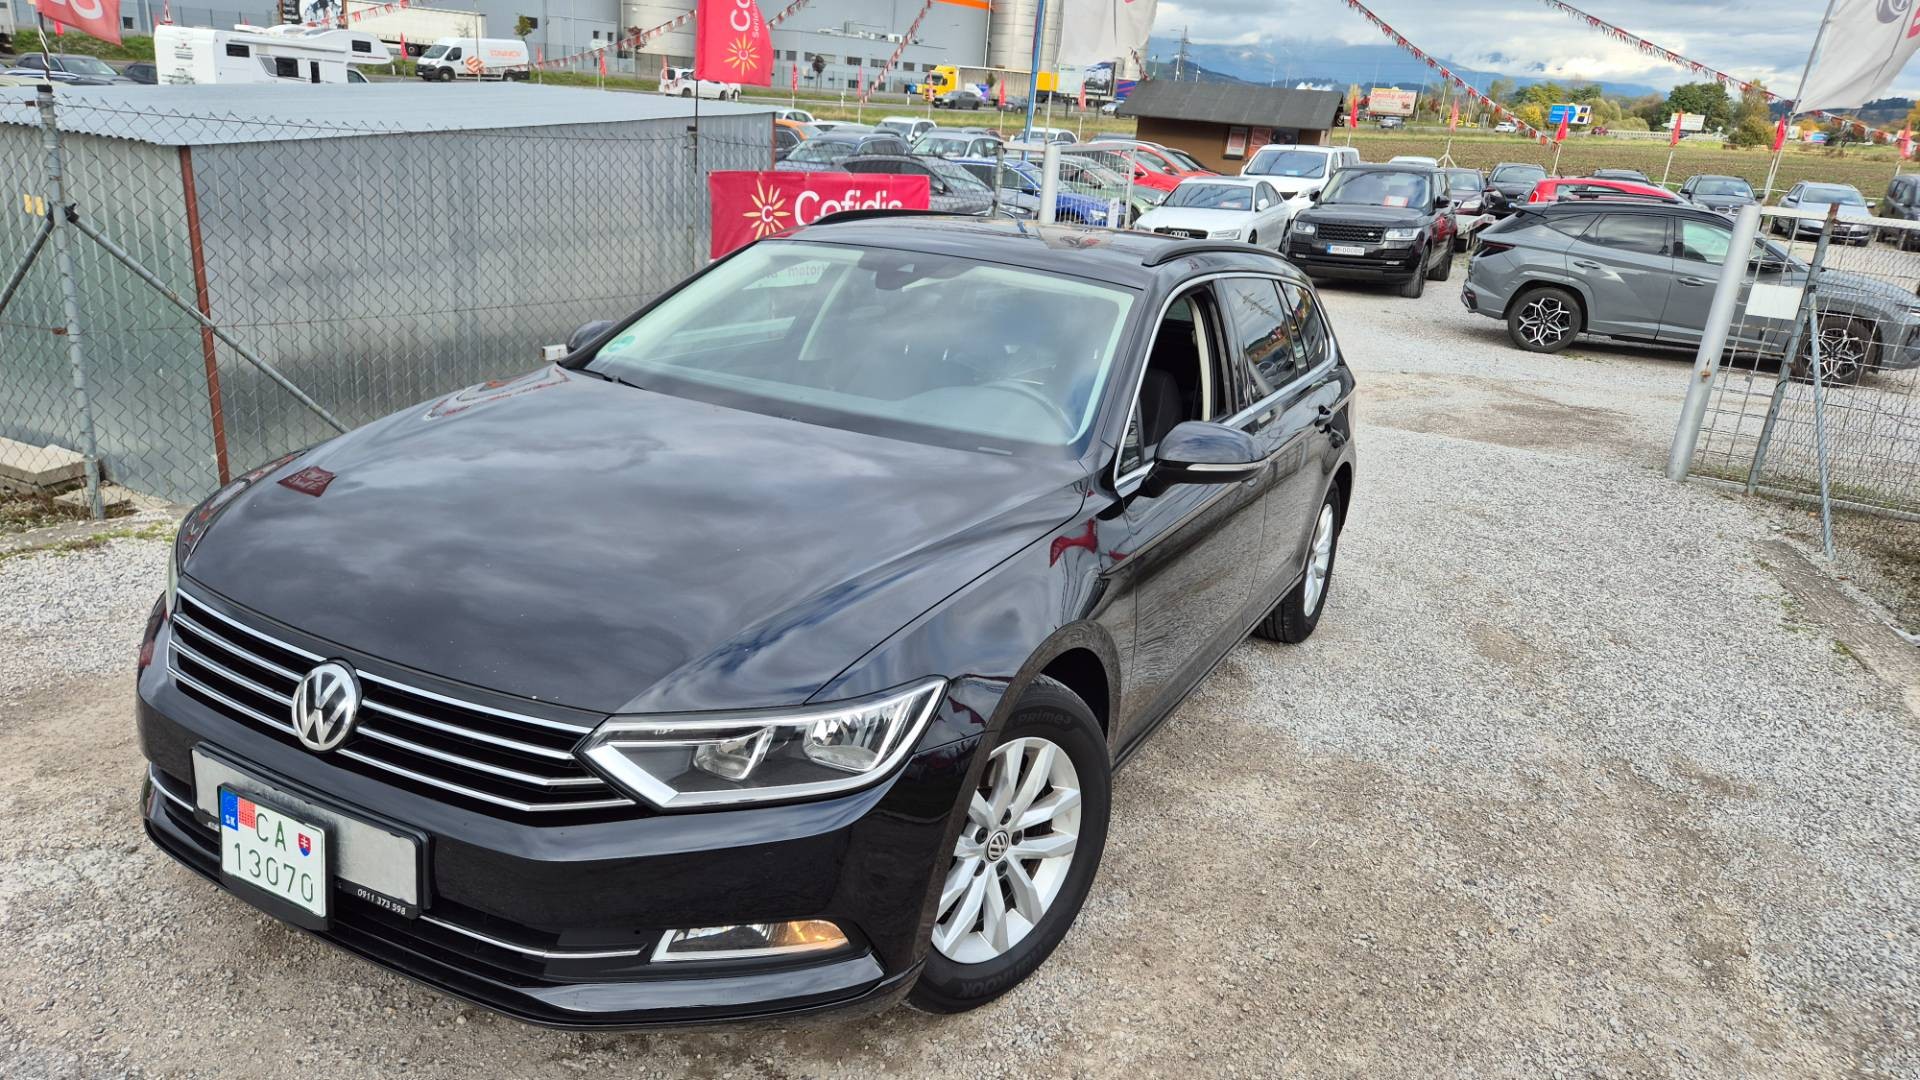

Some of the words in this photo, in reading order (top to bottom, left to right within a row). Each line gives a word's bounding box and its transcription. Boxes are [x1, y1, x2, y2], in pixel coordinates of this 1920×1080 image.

[225, 814, 236, 828] SK
[256, 812, 287, 852] CA
[234, 842, 314, 903] 13070
[357, 888, 375, 903] 0911
[376, 895, 391, 909] 373
[391, 902, 406, 916] 598
